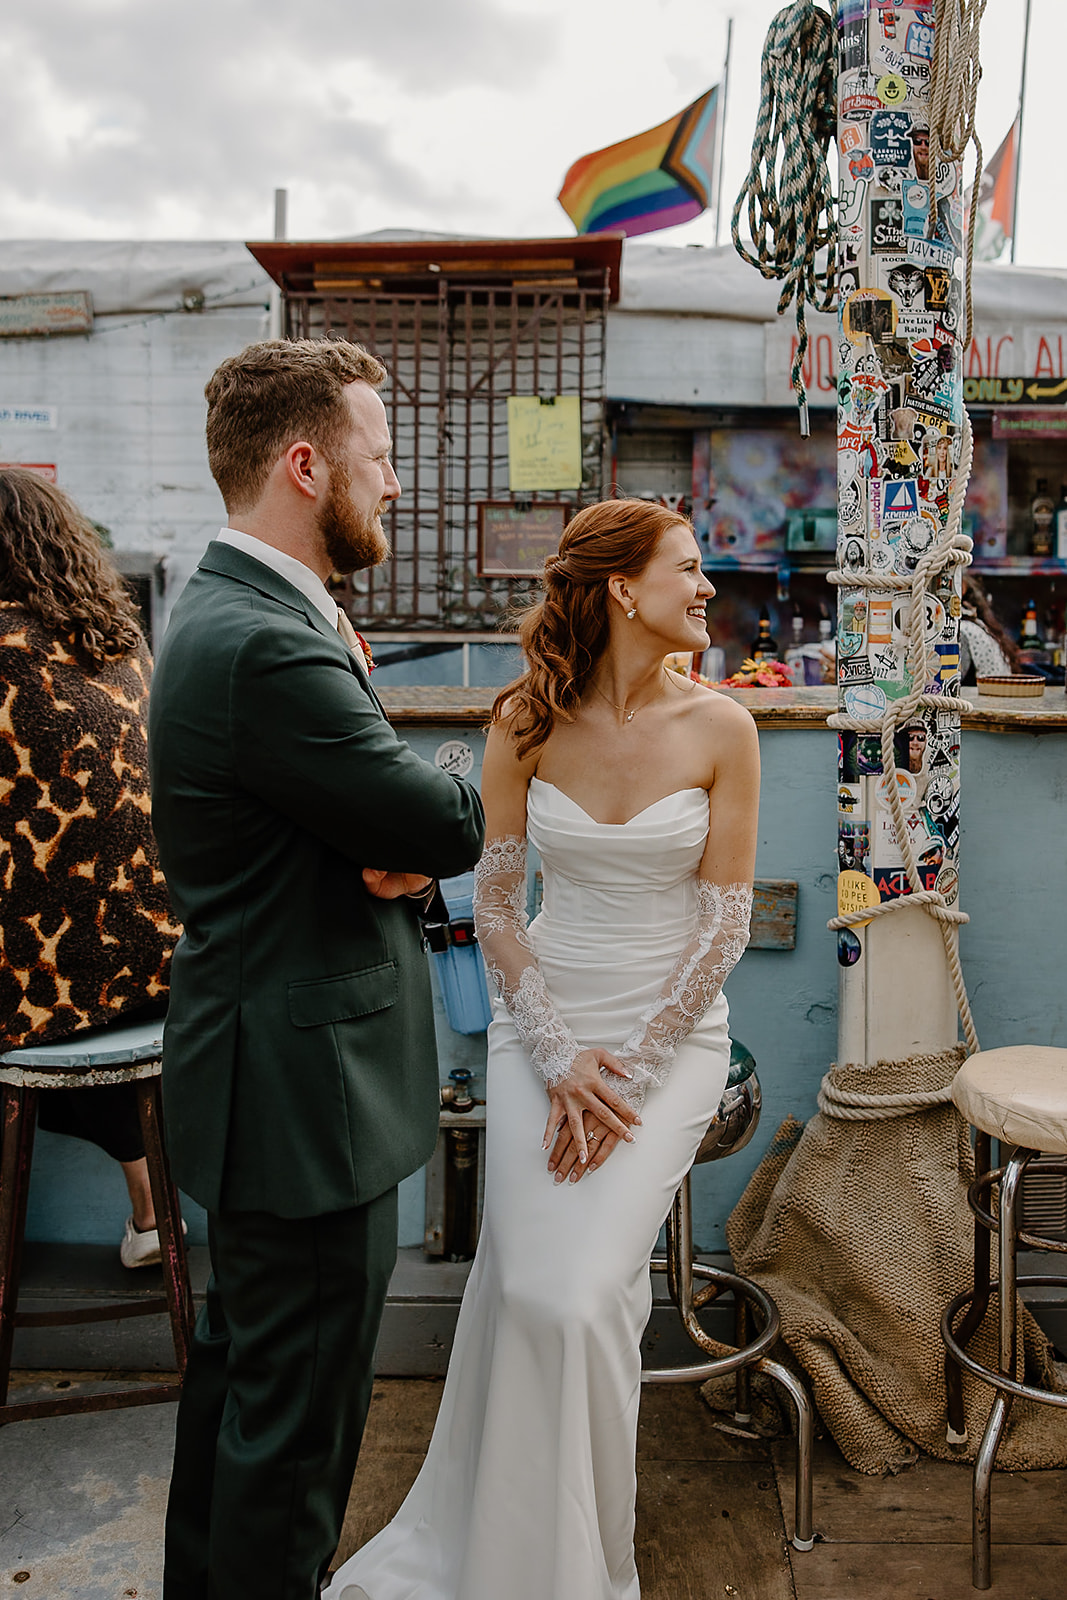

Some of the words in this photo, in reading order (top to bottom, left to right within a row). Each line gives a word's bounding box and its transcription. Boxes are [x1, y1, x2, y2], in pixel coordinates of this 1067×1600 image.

[873, 223, 907, 248] Snug
[909, 240, 930, 258] J4V
[916, 317, 932, 325] Like
[904, 325, 927, 335] Ralph
[789, 334, 834, 392] NO
[963, 378, 1024, 402] ONLY
[929, 417, 944, 428] OFF
[847, 879, 866, 891] LIKE
[851, 891, 867, 903] PEE
